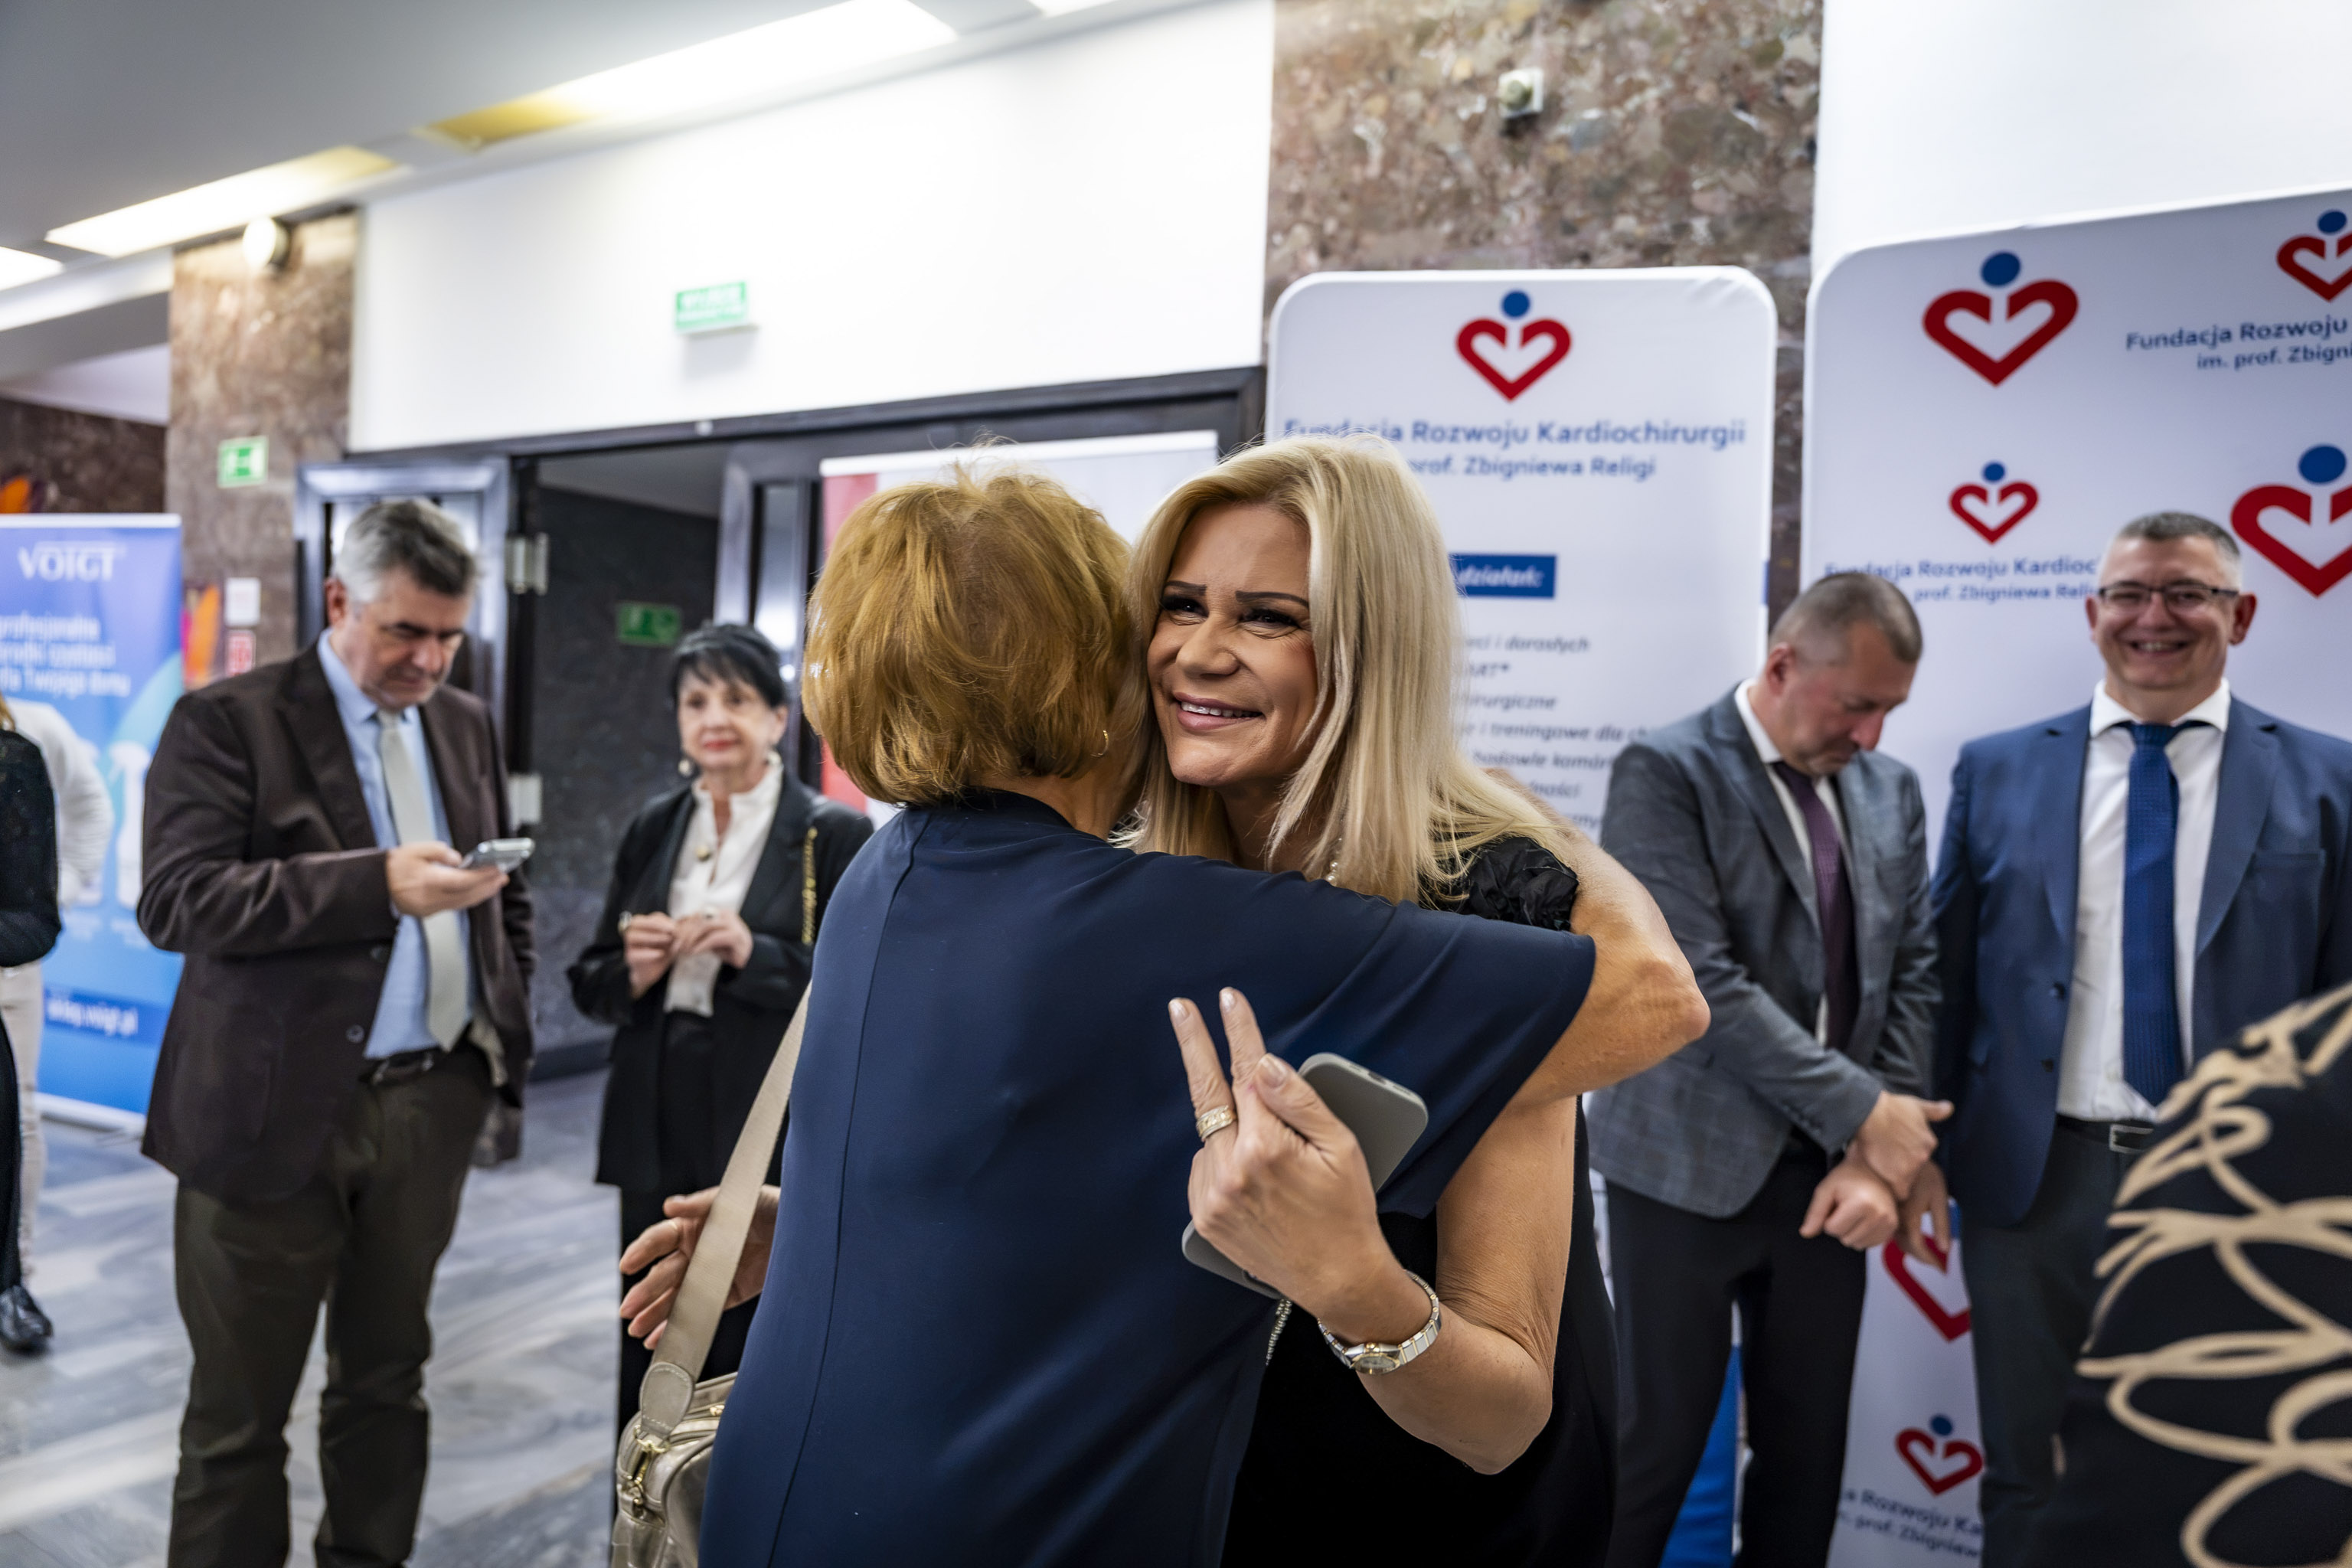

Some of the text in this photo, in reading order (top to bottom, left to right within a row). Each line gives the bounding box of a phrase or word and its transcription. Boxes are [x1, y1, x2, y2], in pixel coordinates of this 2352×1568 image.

[2126, 314, 2349, 351] Fundacja Rozwoju
[2197, 341, 2352, 372] im. prof. Zbigni
[1412, 420, 1530, 451] Rozwoju
[1537, 420, 1745, 452] Kardiochirurgii
[1464, 455, 1583, 482] Zbigniewa
[1590, 454, 1656, 482] Religi
[18, 541, 116, 583] VOIGT
[1917, 557, 2009, 581] Rozwoju
[2013, 554, 2100, 577] Kardioc
[1915, 582, 2096, 605] prof. Zbigniewa Reli
[1860, 1489, 1951, 1528] Rozwoju
[1900, 1524, 1980, 1557] Zbigniew
